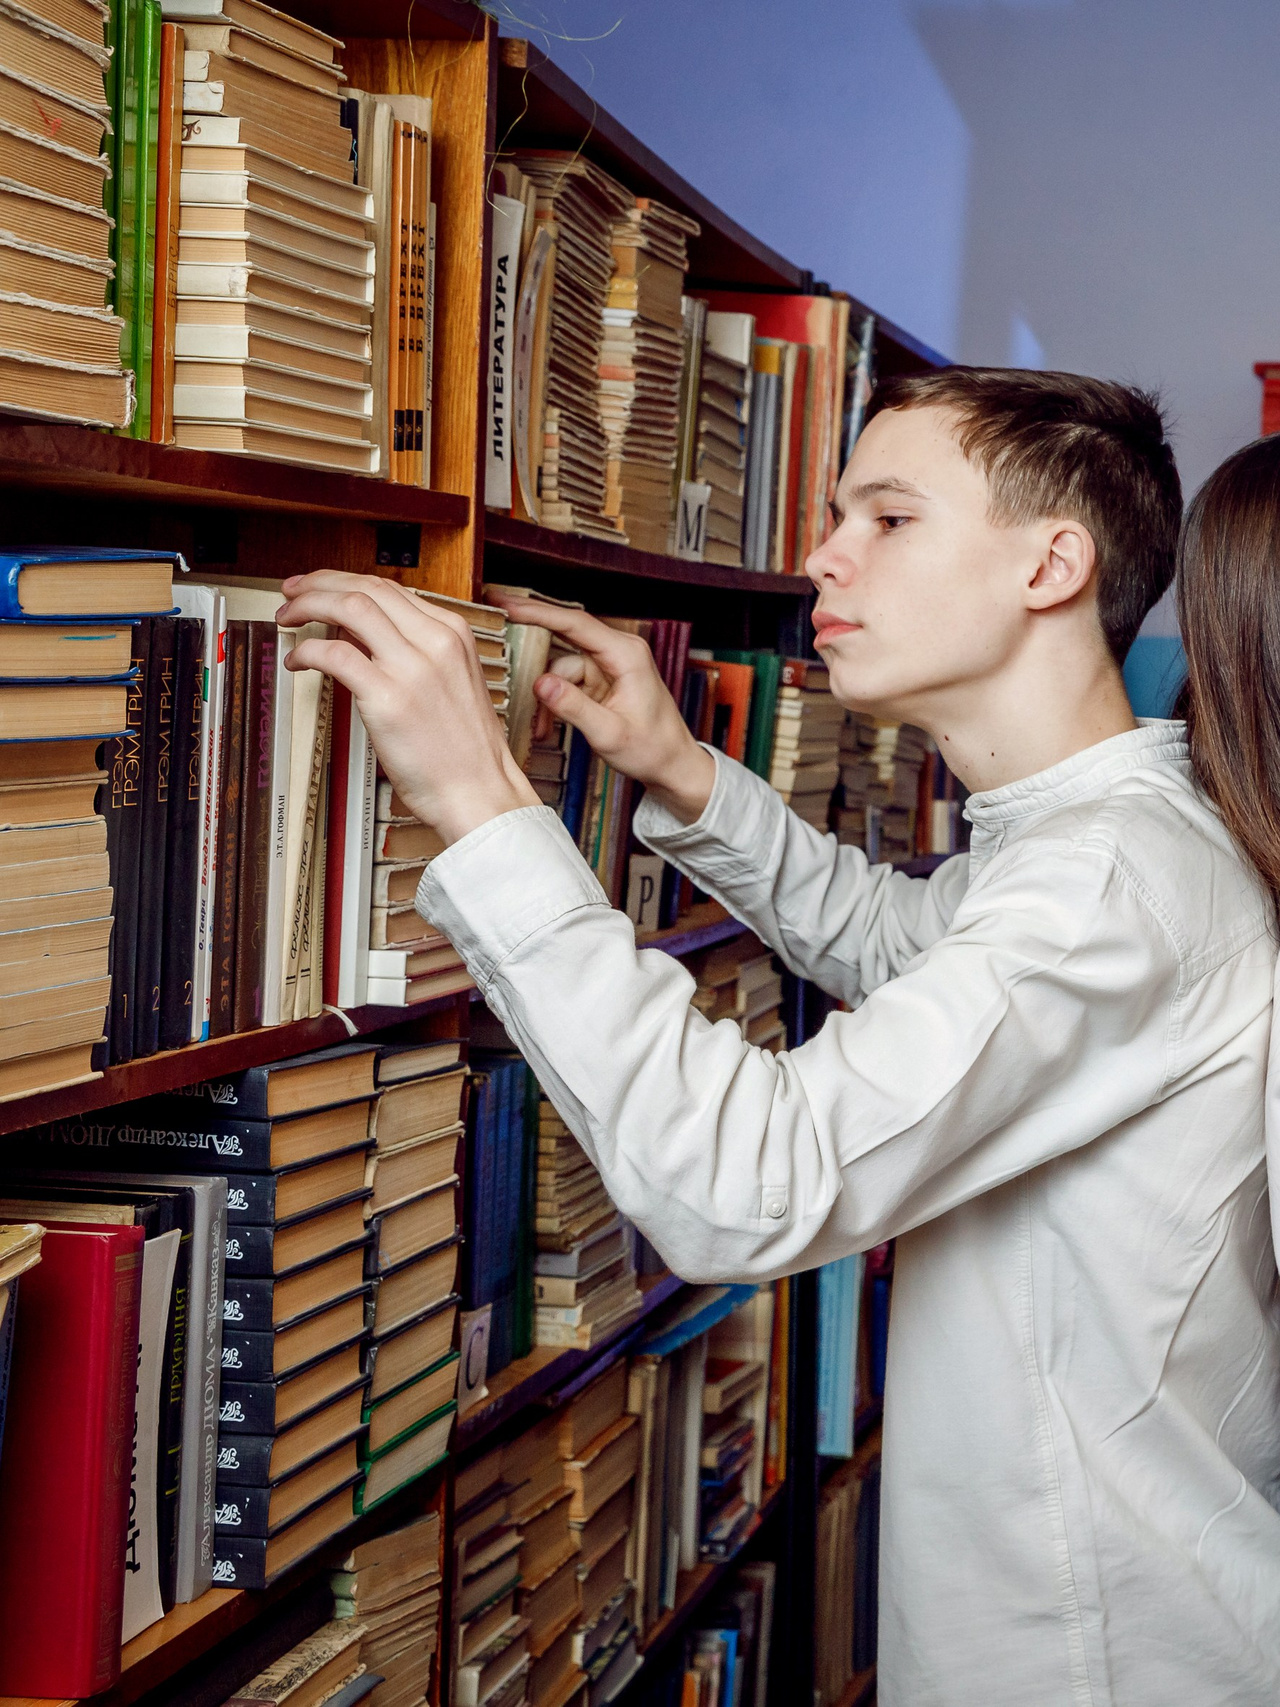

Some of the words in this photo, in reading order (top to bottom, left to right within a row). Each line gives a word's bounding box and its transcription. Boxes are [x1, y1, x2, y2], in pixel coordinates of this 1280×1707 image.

[493, 255, 509, 461] ЛИТЕРАТУРА
[159, 658, 172, 723] ГРИН
[124, 733, 140, 806] ГРЭМ
[158, 731, 170, 802] ГРЭМ
[188, 731, 201, 800] ГРЭМ
[201, 837, 209, 886] Вождь
[205, 728, 214, 831] краснокожих
[363, 797, 371, 849] ИОГАНН
[117, 1127, 229, 1155] Александр
[207, 1247, 219, 1319] Кавказ
[203, 1343, 216, 1430] ДЮМА
[200, 1433, 214, 1548] Александр
